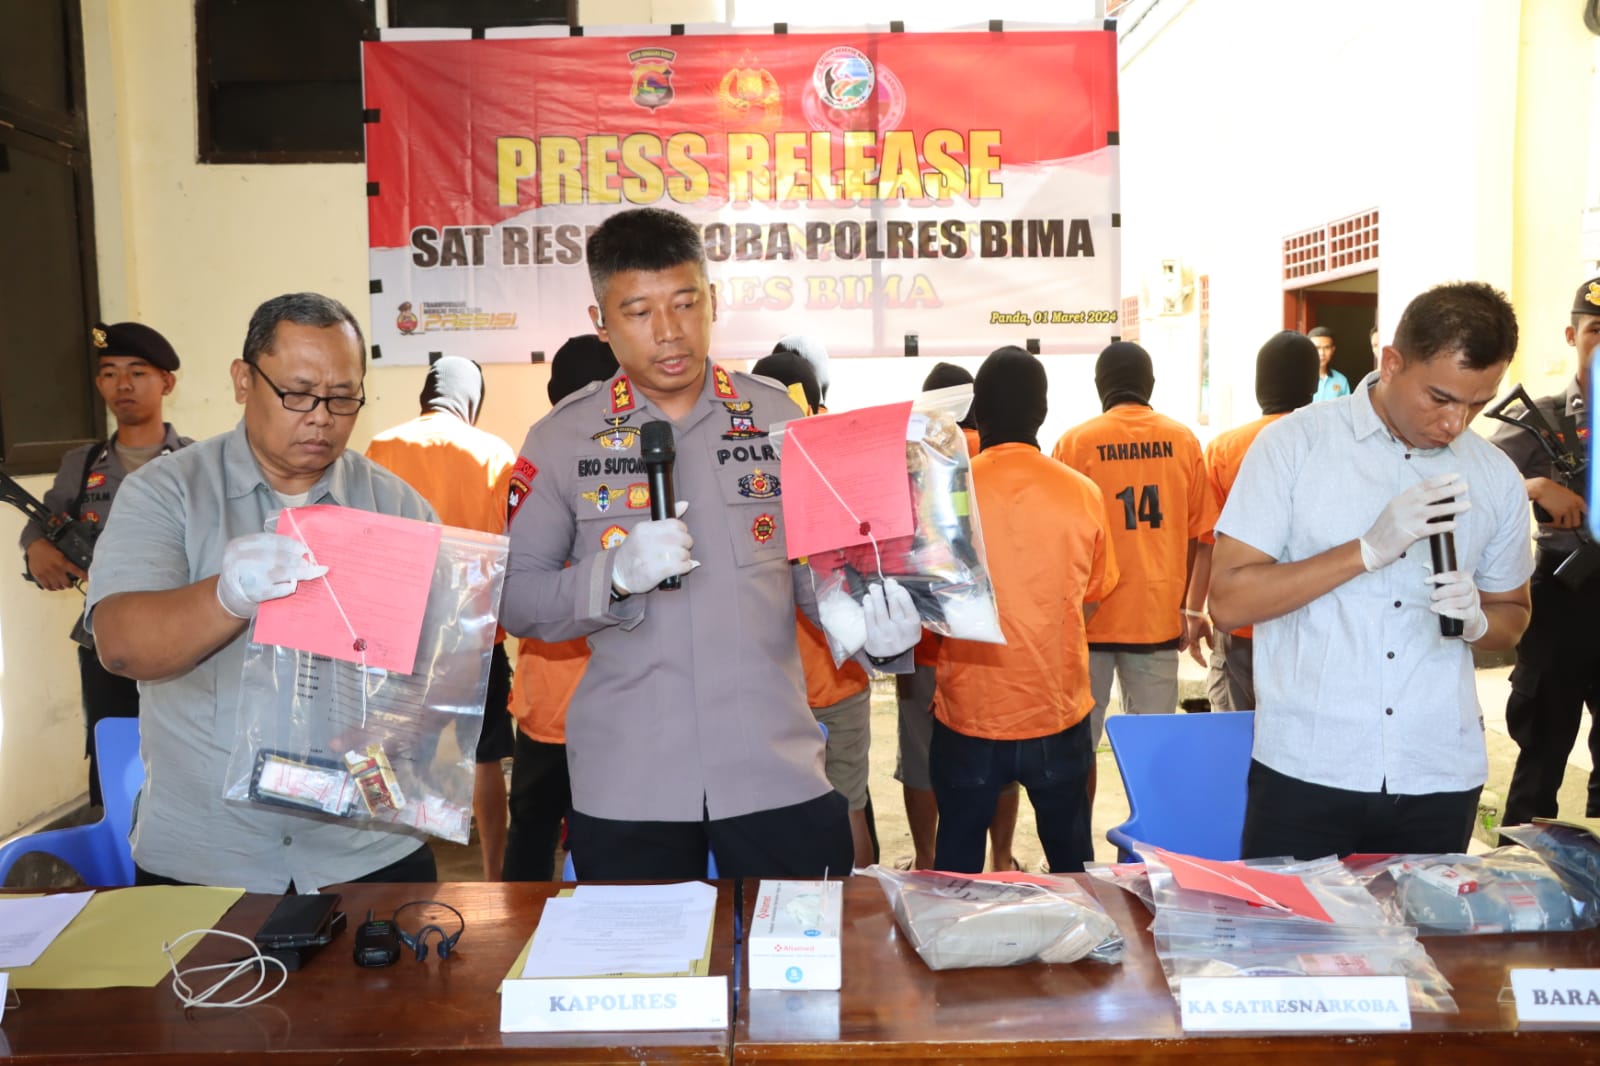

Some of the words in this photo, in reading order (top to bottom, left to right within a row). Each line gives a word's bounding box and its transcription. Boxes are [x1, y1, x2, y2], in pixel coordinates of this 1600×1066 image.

[496, 131, 711, 207] PRESS
[726, 129, 1003, 201] RELEASE
[411, 226, 491, 268] SAT
[806, 220, 969, 260] POLRES
[980, 218, 1095, 259] BIMA
[804, 273, 944, 311] BIMA
[990, 311, 1031, 325] Panda,
[1033, 311, 1049, 324] 01
[1051, 311, 1086, 324] Maret
[1087, 310, 1118, 324] 2024
[716, 443, 781, 466] POLR
[1096, 441, 1173, 461] TAHANAN
[578, 458, 601, 477] EKO
[604, 456, 649, 475] SUTOM
[1115, 484, 1163, 530] 14
[549, 992, 678, 1013] KAPOLRES
[1188, 999, 1217, 1014] KA
[1222, 998, 1400, 1015] SATRESNARKOBA
